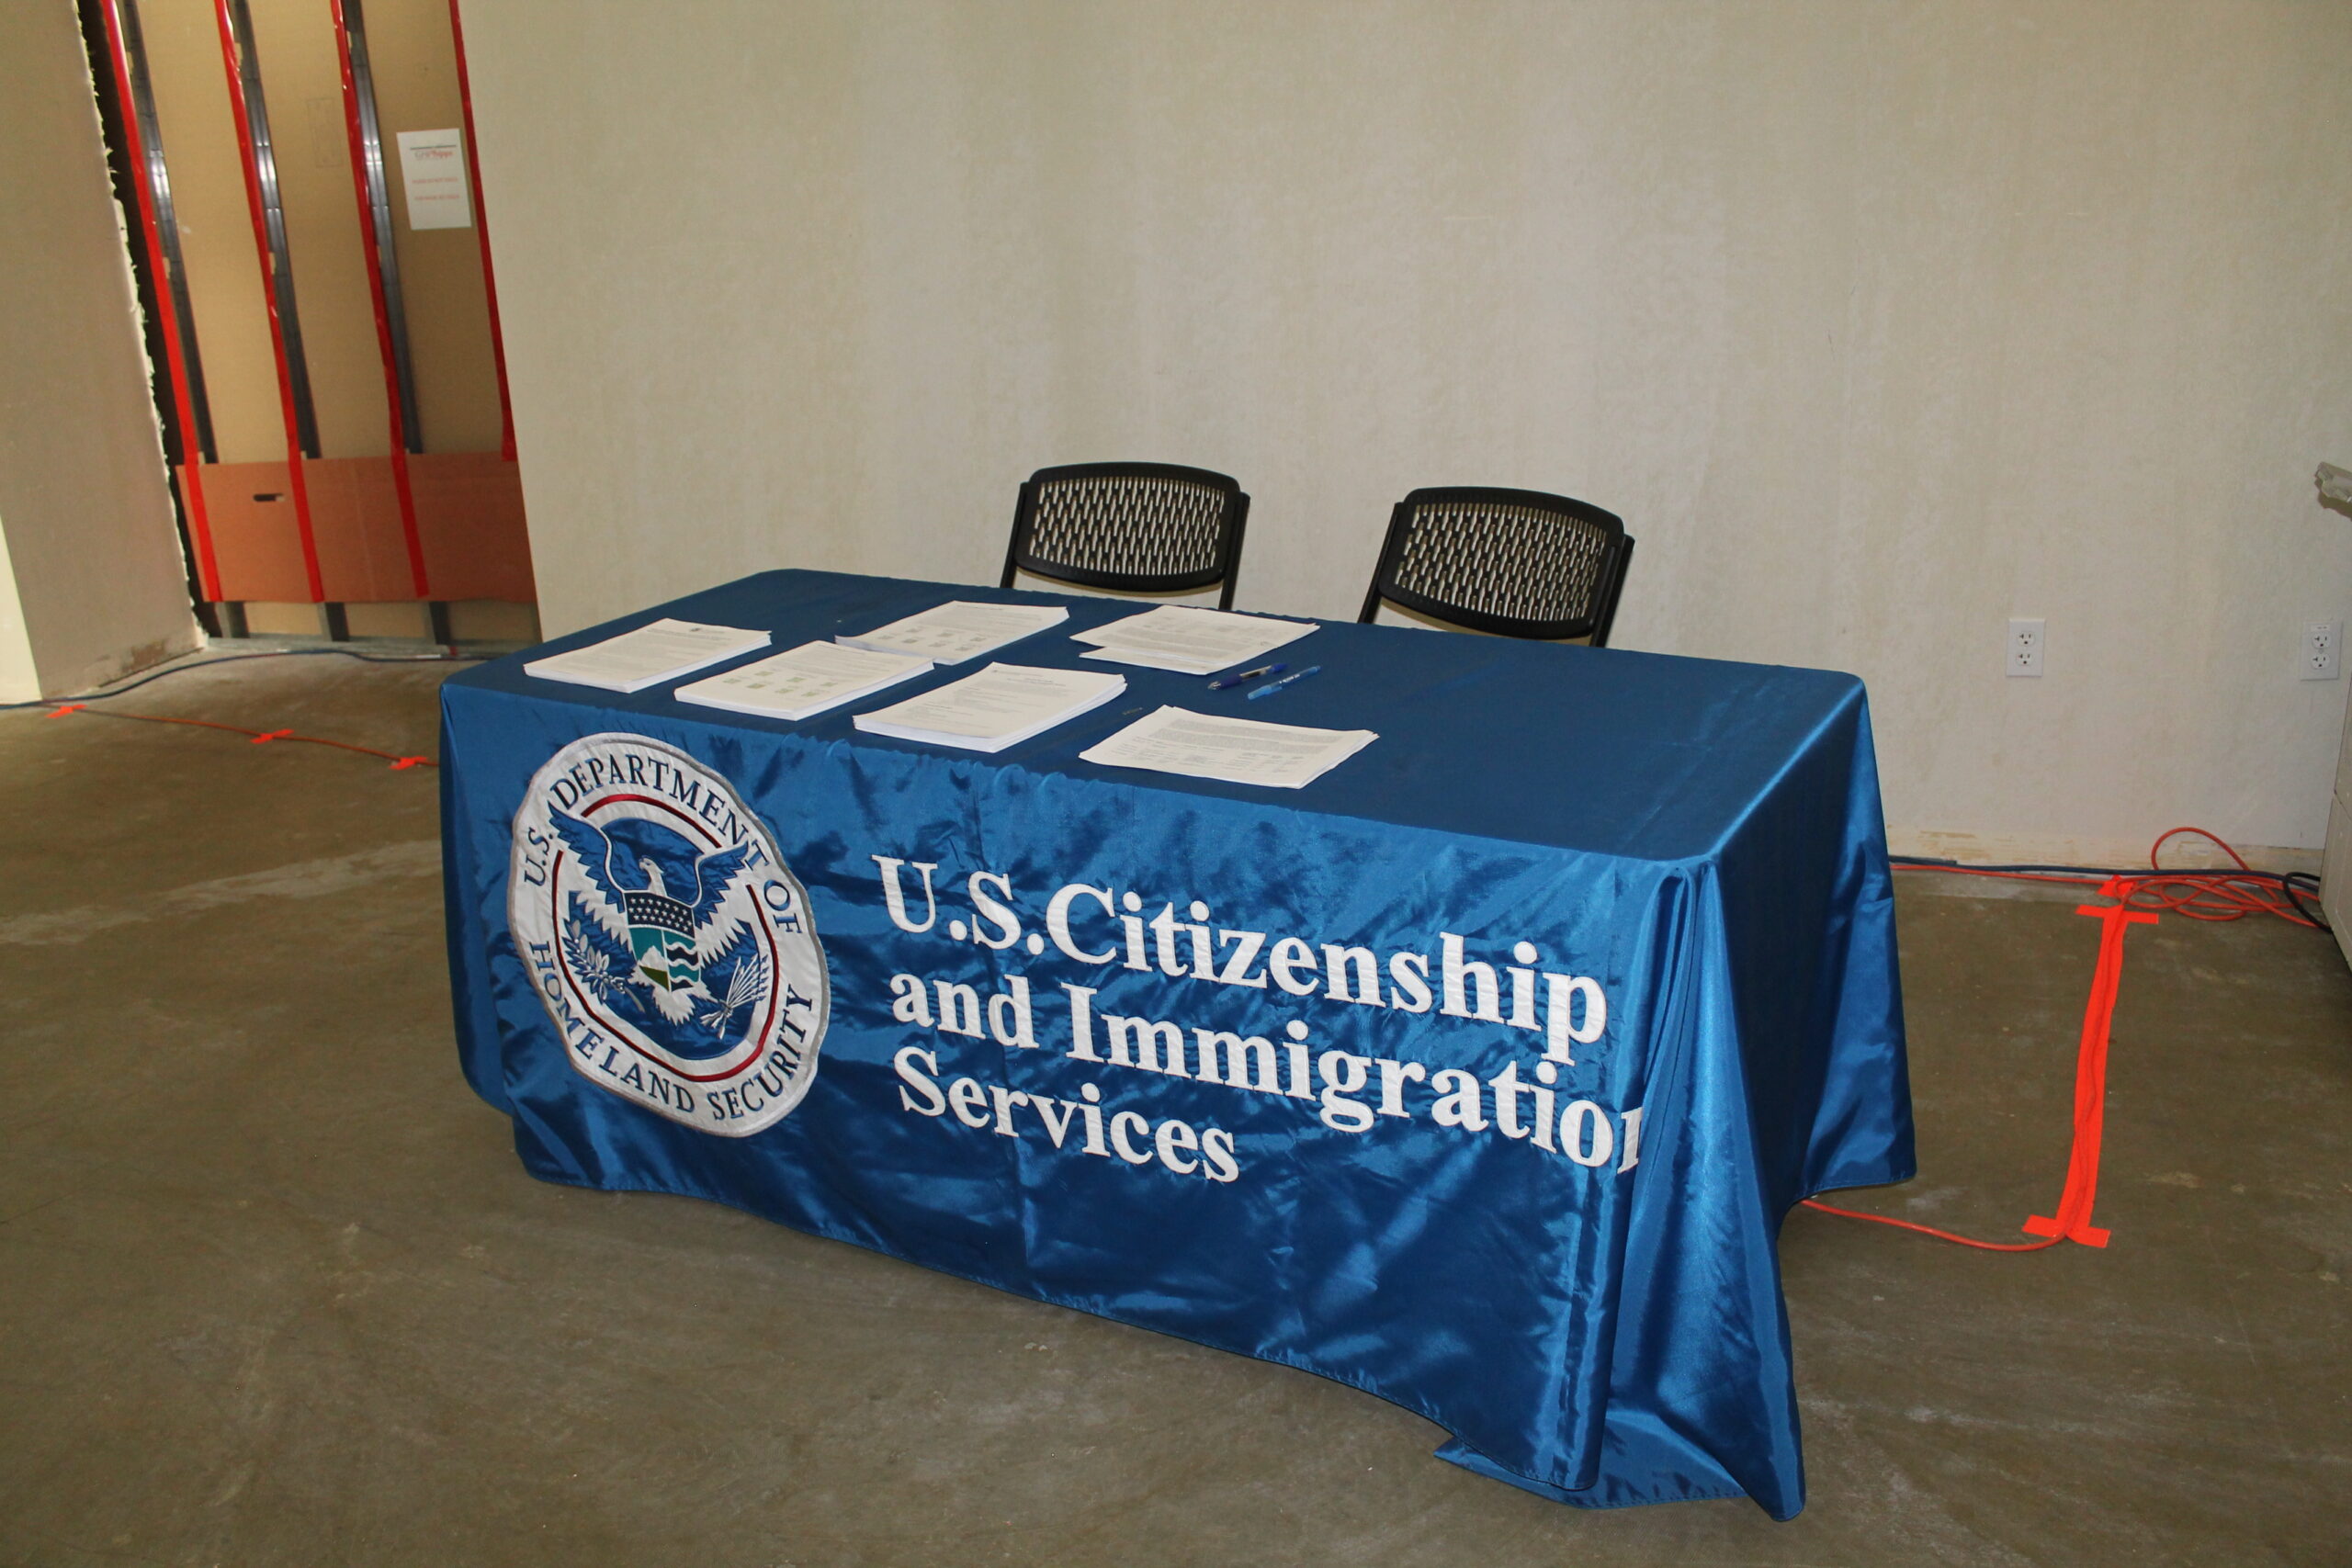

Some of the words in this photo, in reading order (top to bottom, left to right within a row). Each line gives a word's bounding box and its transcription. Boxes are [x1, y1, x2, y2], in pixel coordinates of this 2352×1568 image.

[524, 826, 555, 887] U.S.
[549, 754, 770, 873] DEPARTMENT
[763, 879, 803, 935] OF
[528, 940, 695, 1113] HOMELAND
[707, 984, 813, 1121] SECURITY
[888, 971, 1040, 1049] and
[892, 1045, 1240, 1183] Services
